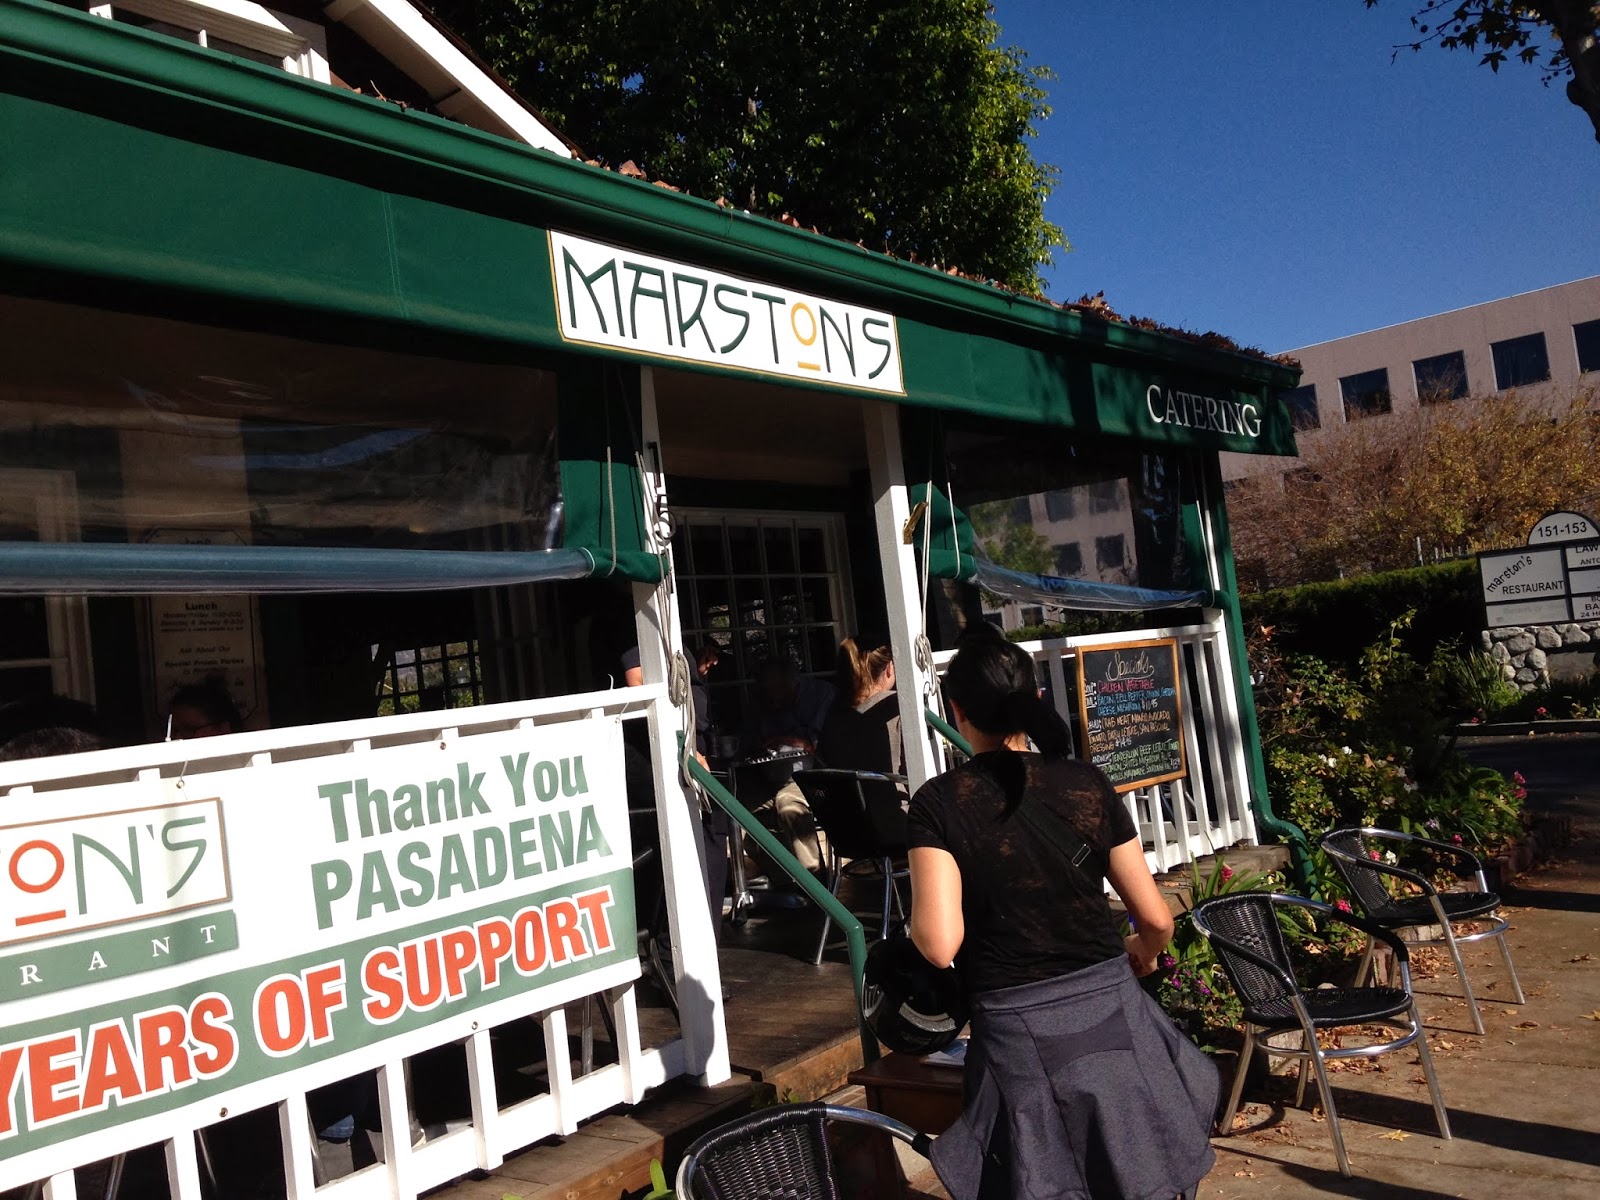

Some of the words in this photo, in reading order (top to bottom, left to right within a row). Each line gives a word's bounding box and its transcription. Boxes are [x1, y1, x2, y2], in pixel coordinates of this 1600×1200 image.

[562, 245, 893, 380] MARSTONS
[1147, 384, 1262, 438] CATERING
[1538, 521, 1587, 538] 151-153
[1486, 555, 1532, 593] marston's
[1502, 580, 1564, 595] RESTAURANT
[184, 602, 218, 610] Lunch
[1098, 681, 1123, 695] CHICKEN
[317, 761, 487, 844] Thank
[500, 752, 588, 806] You
[0, 816, 207, 922] ON'S
[310, 803, 613, 930] PASADENA
[257, 965, 345, 1054] OF
[365, 888, 615, 1022] SUPPORT
